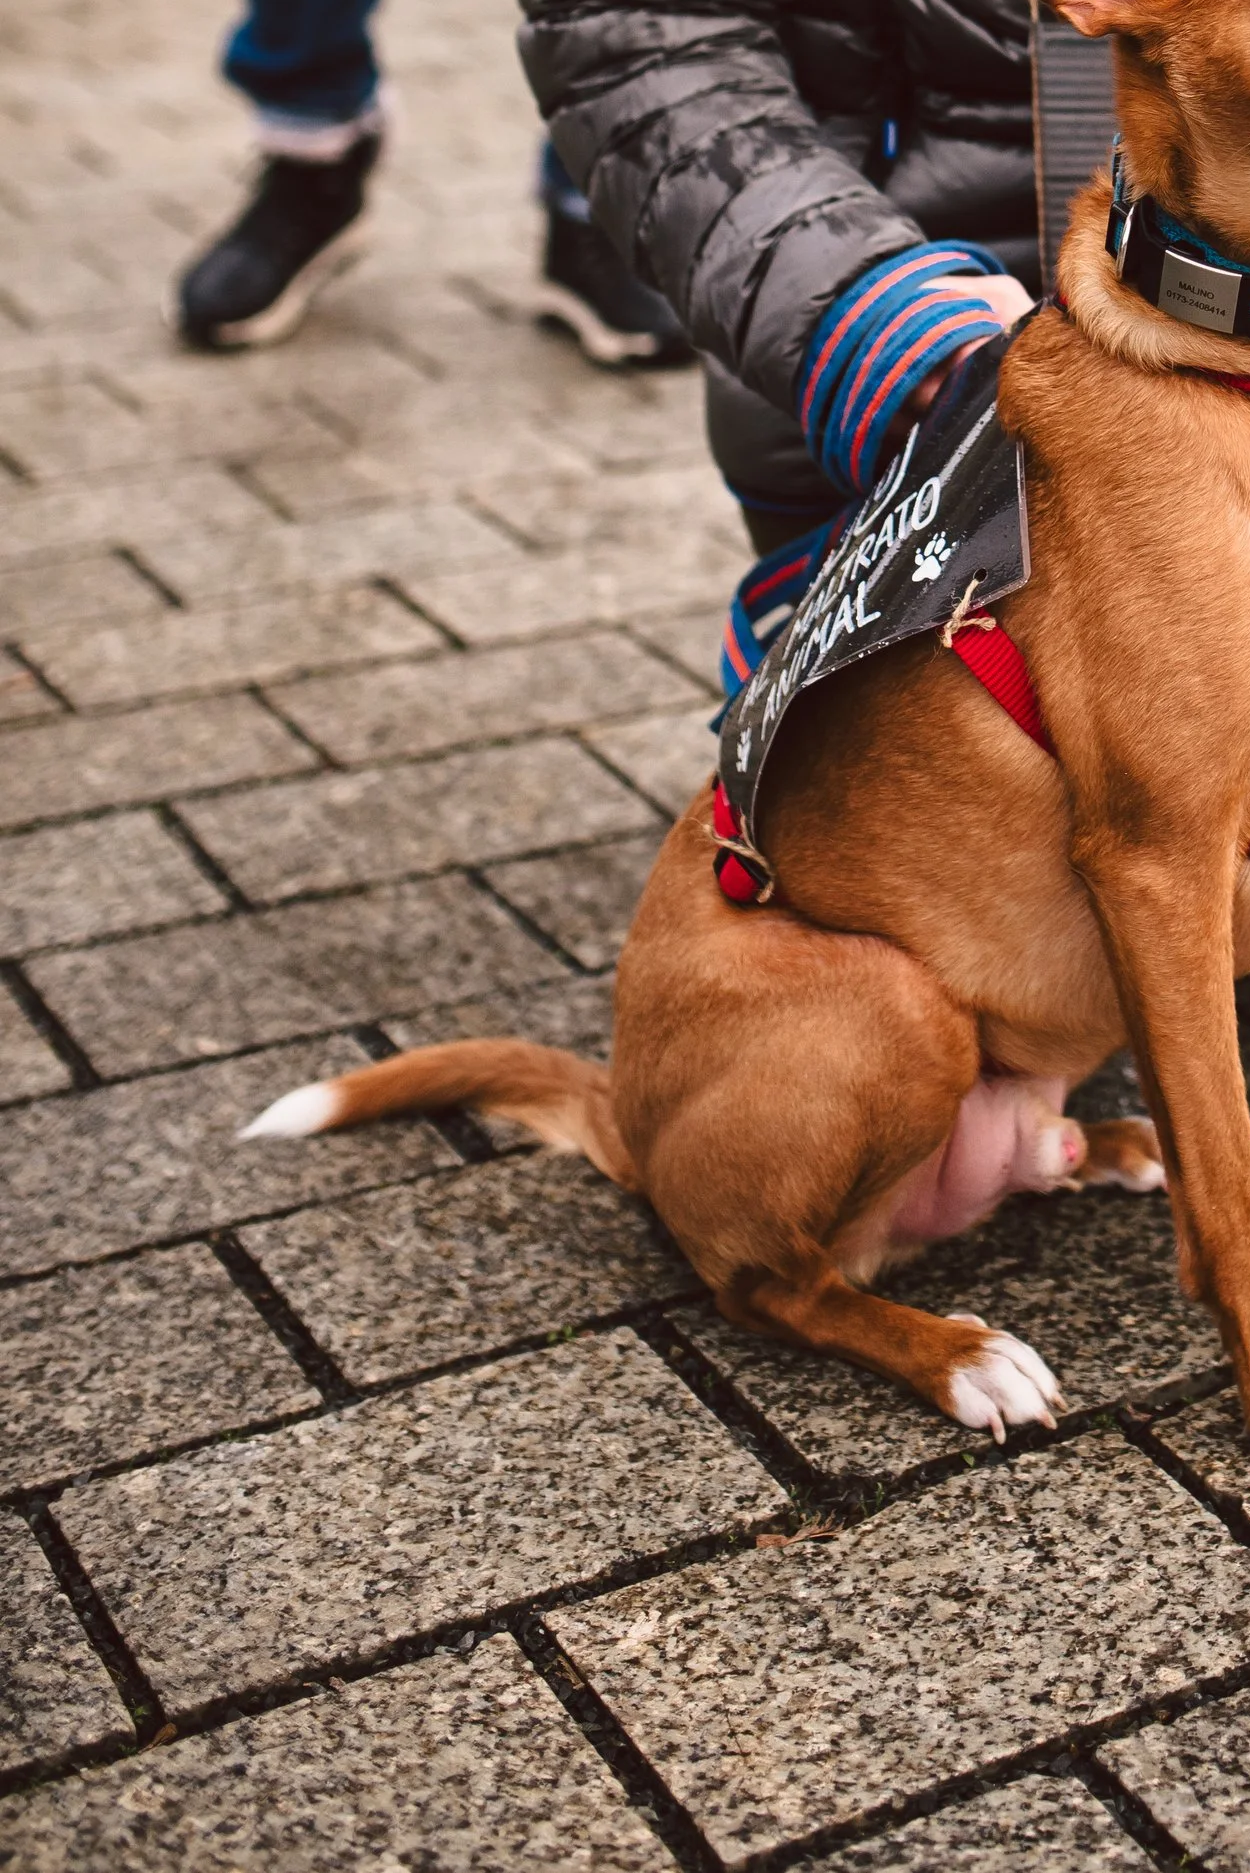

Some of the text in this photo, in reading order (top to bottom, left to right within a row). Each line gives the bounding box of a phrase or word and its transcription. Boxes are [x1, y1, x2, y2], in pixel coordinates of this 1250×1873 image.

[1178, 280, 1215, 300] MALINO
[781, 475, 941, 662] MALTRATO
[760, 580, 882, 743] ANIMAL
